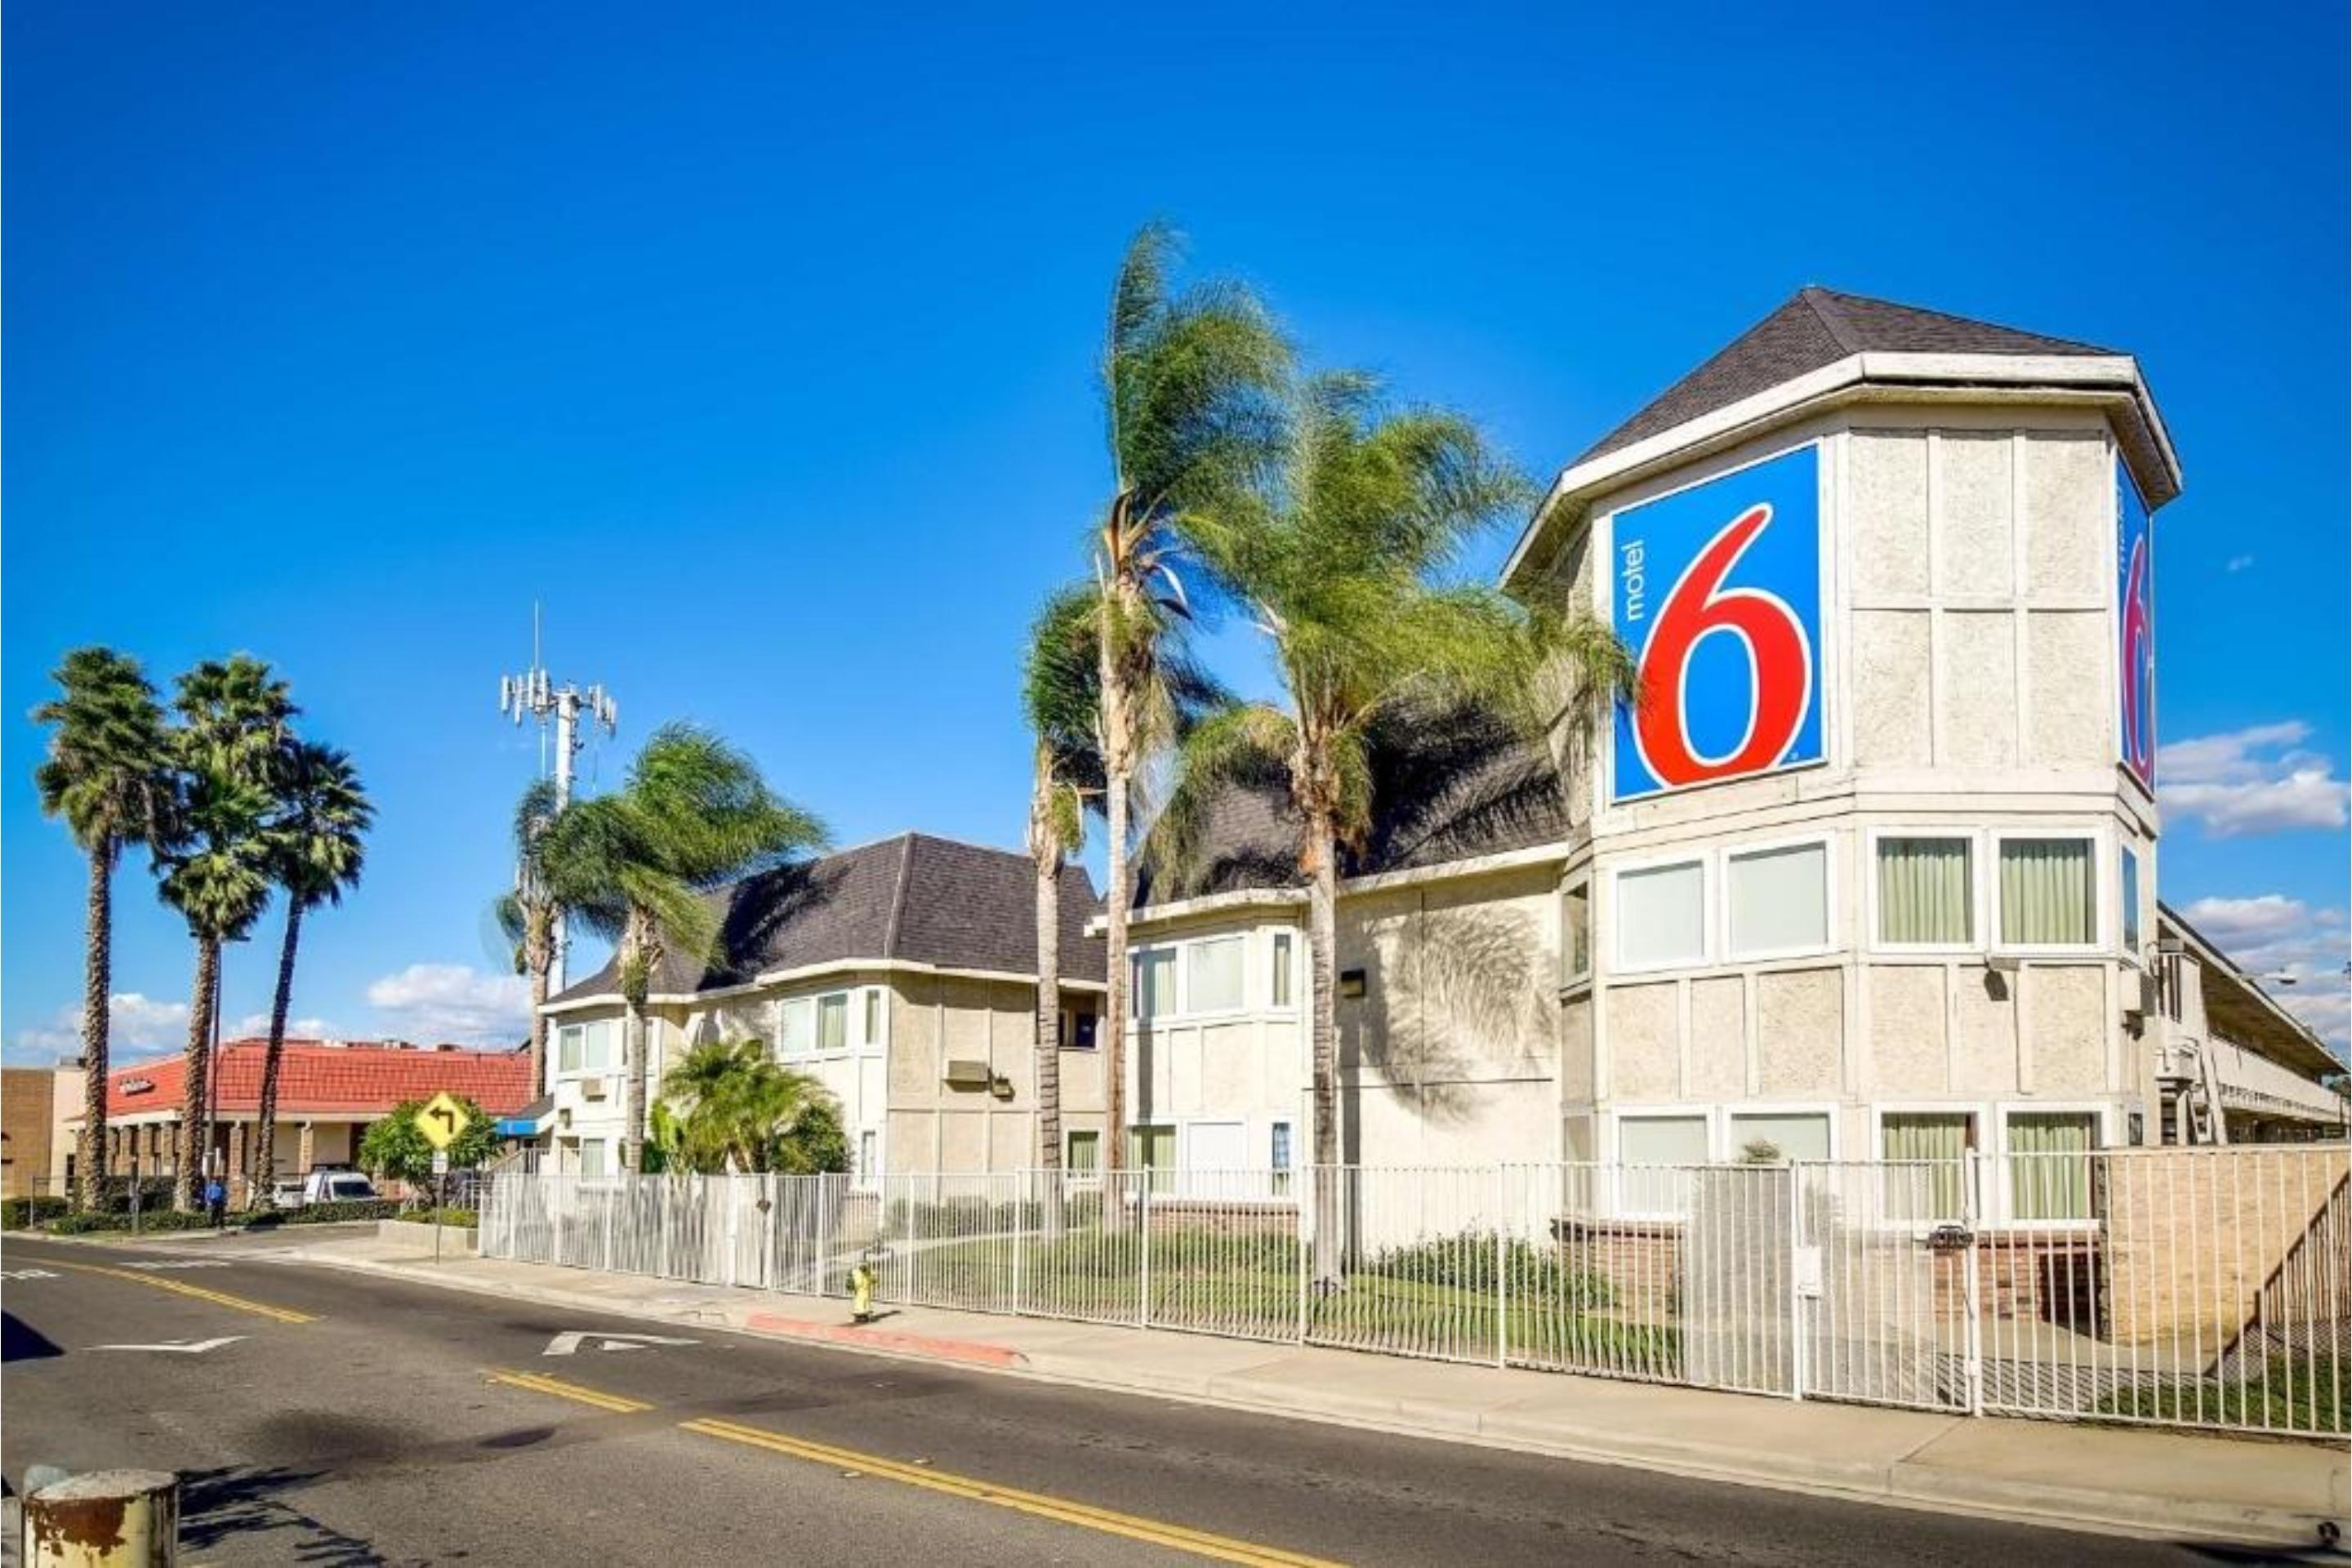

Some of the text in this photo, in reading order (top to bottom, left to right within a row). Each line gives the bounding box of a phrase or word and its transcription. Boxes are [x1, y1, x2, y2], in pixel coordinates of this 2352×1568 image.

[1620, 540, 1645, 621] motel
[1635, 501, 1812, 789] 6
[2123, 532, 2153, 786] 6
